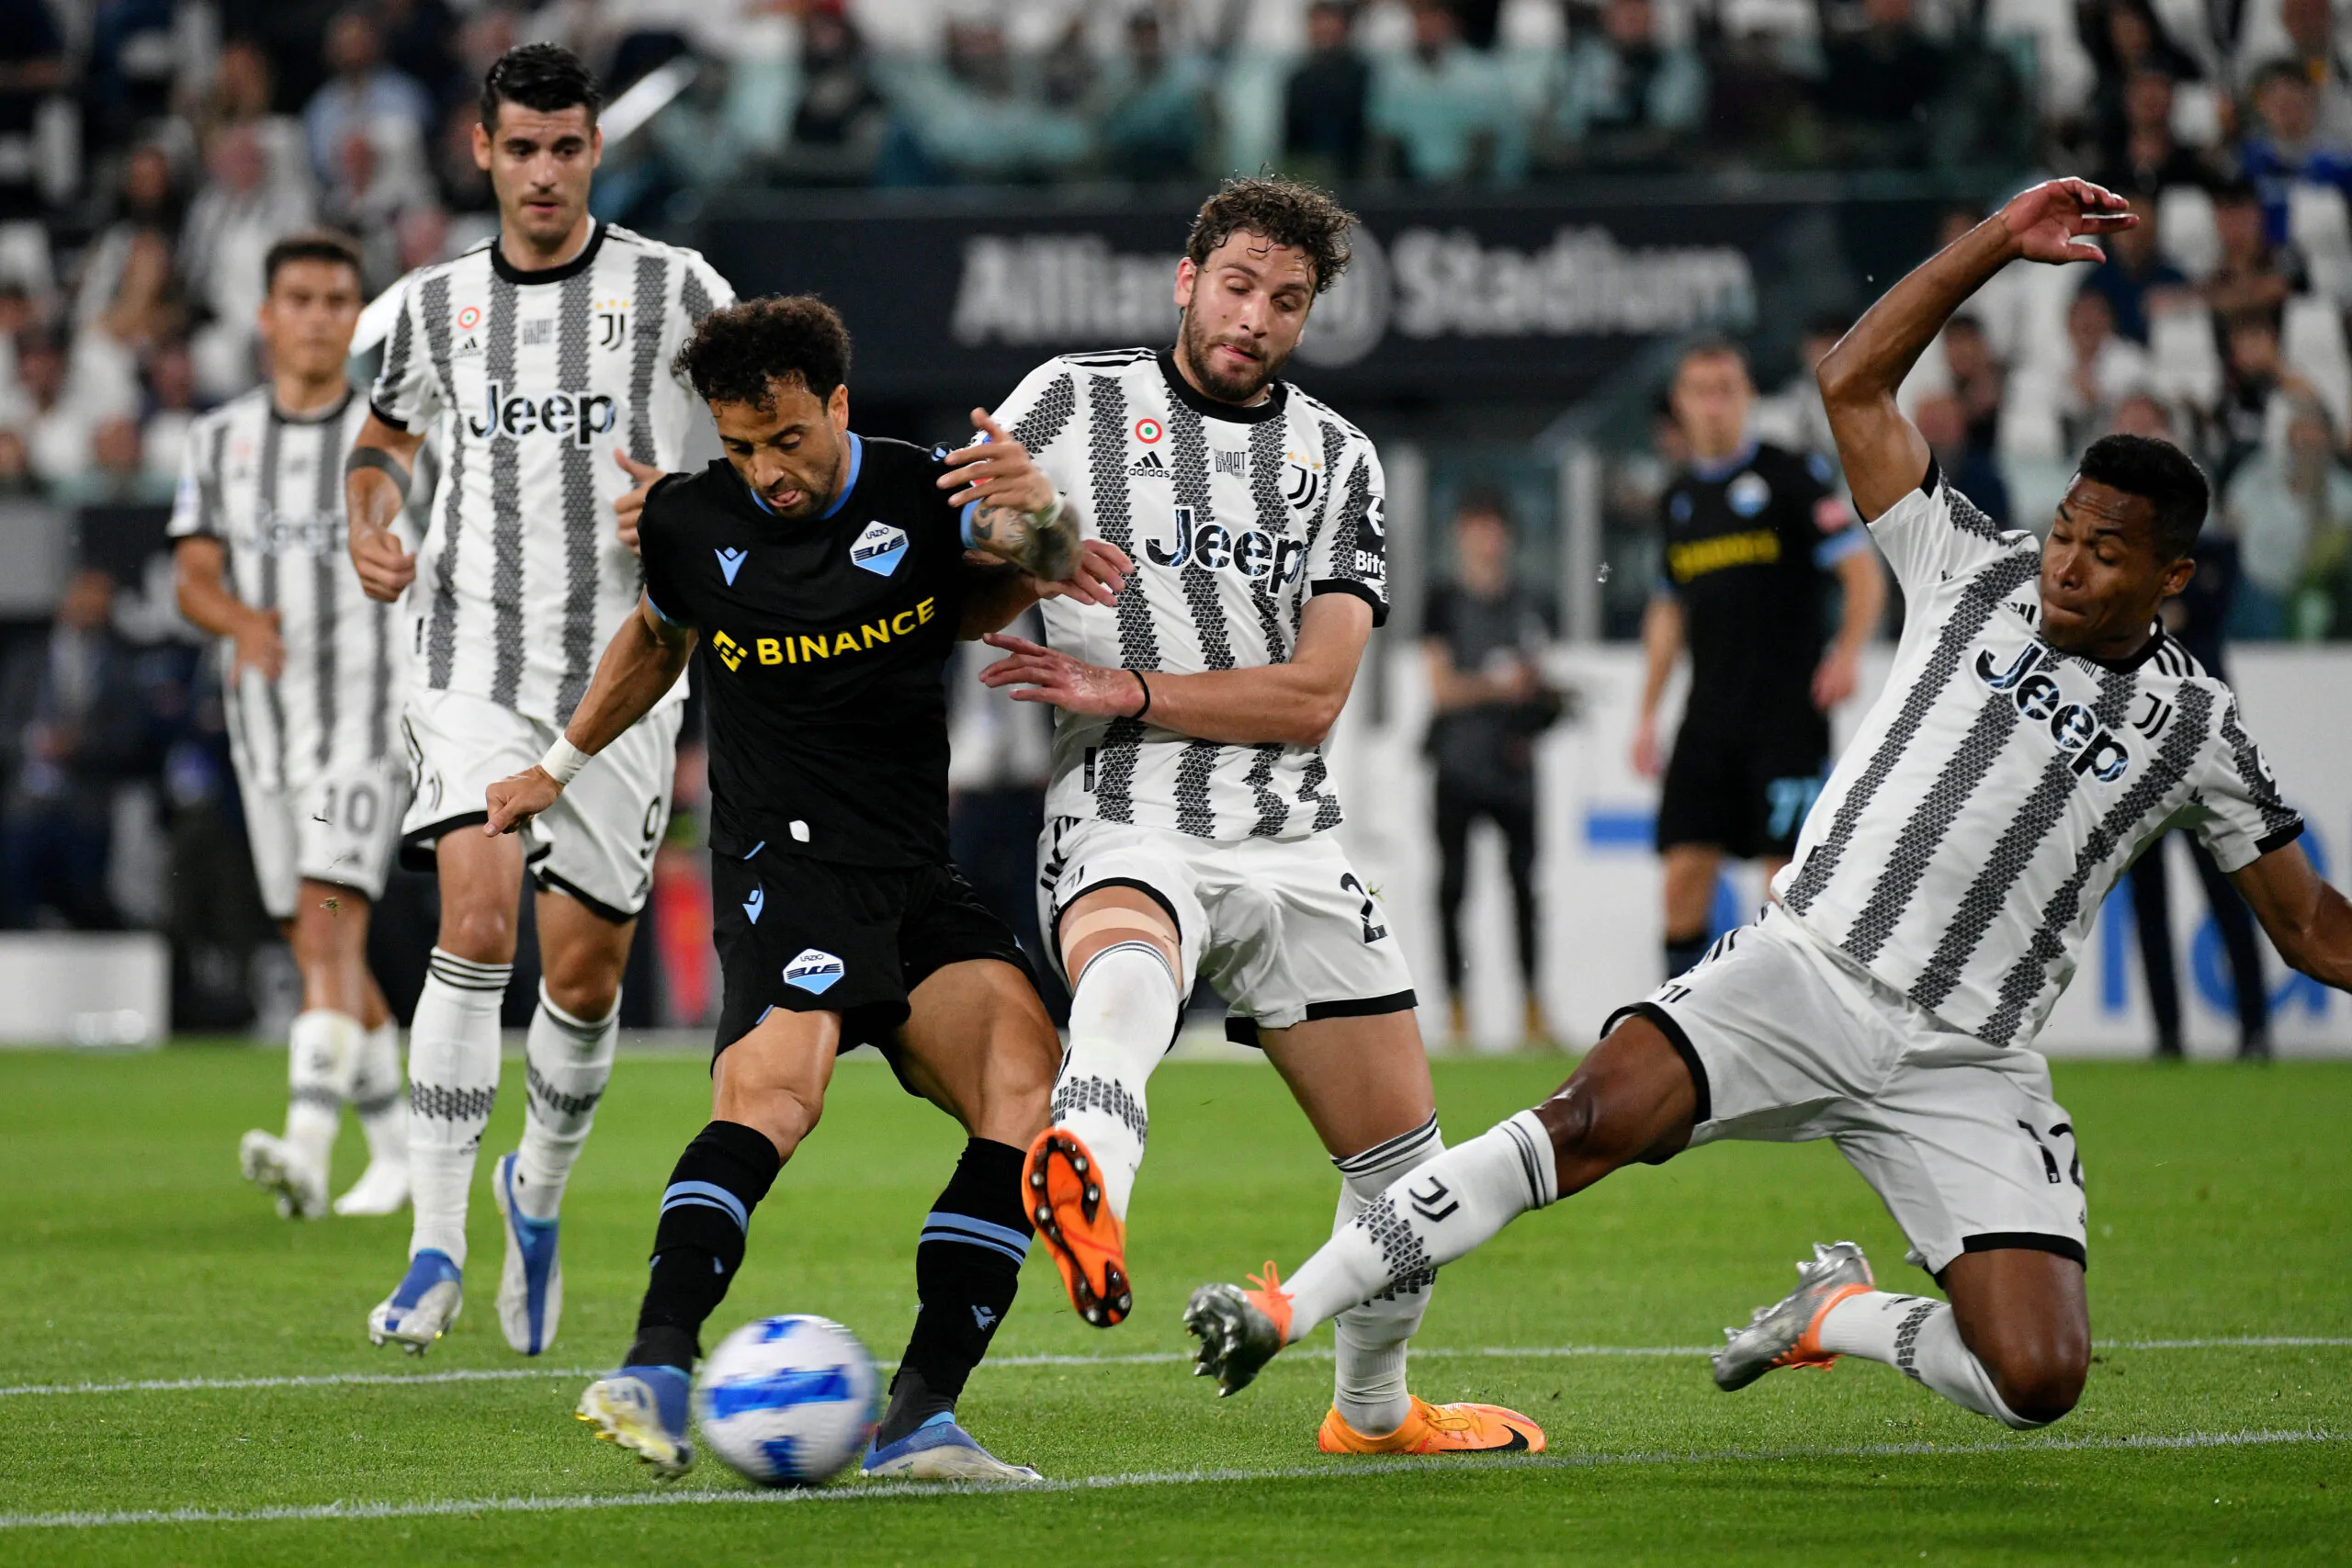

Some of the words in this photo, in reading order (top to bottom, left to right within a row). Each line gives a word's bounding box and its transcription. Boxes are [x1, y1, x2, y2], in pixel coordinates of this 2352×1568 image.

[1391, 228, 1757, 338] Stadium
[469, 381, 618, 446] Jeep
[1128, 467, 1170, 479] adidas
[865, 526, 889, 540] LAZIO
[1145, 507, 1306, 595] Jeep
[756, 597, 935, 665] BINANCE
[1975, 641, 2130, 783] Jeep
[325, 781, 379, 835] 10
[640, 795, 662, 860] 9
[1340, 873, 1388, 943] 2
[800, 953, 824, 963] LAZIO
[2017, 1119, 2085, 1193] 12
